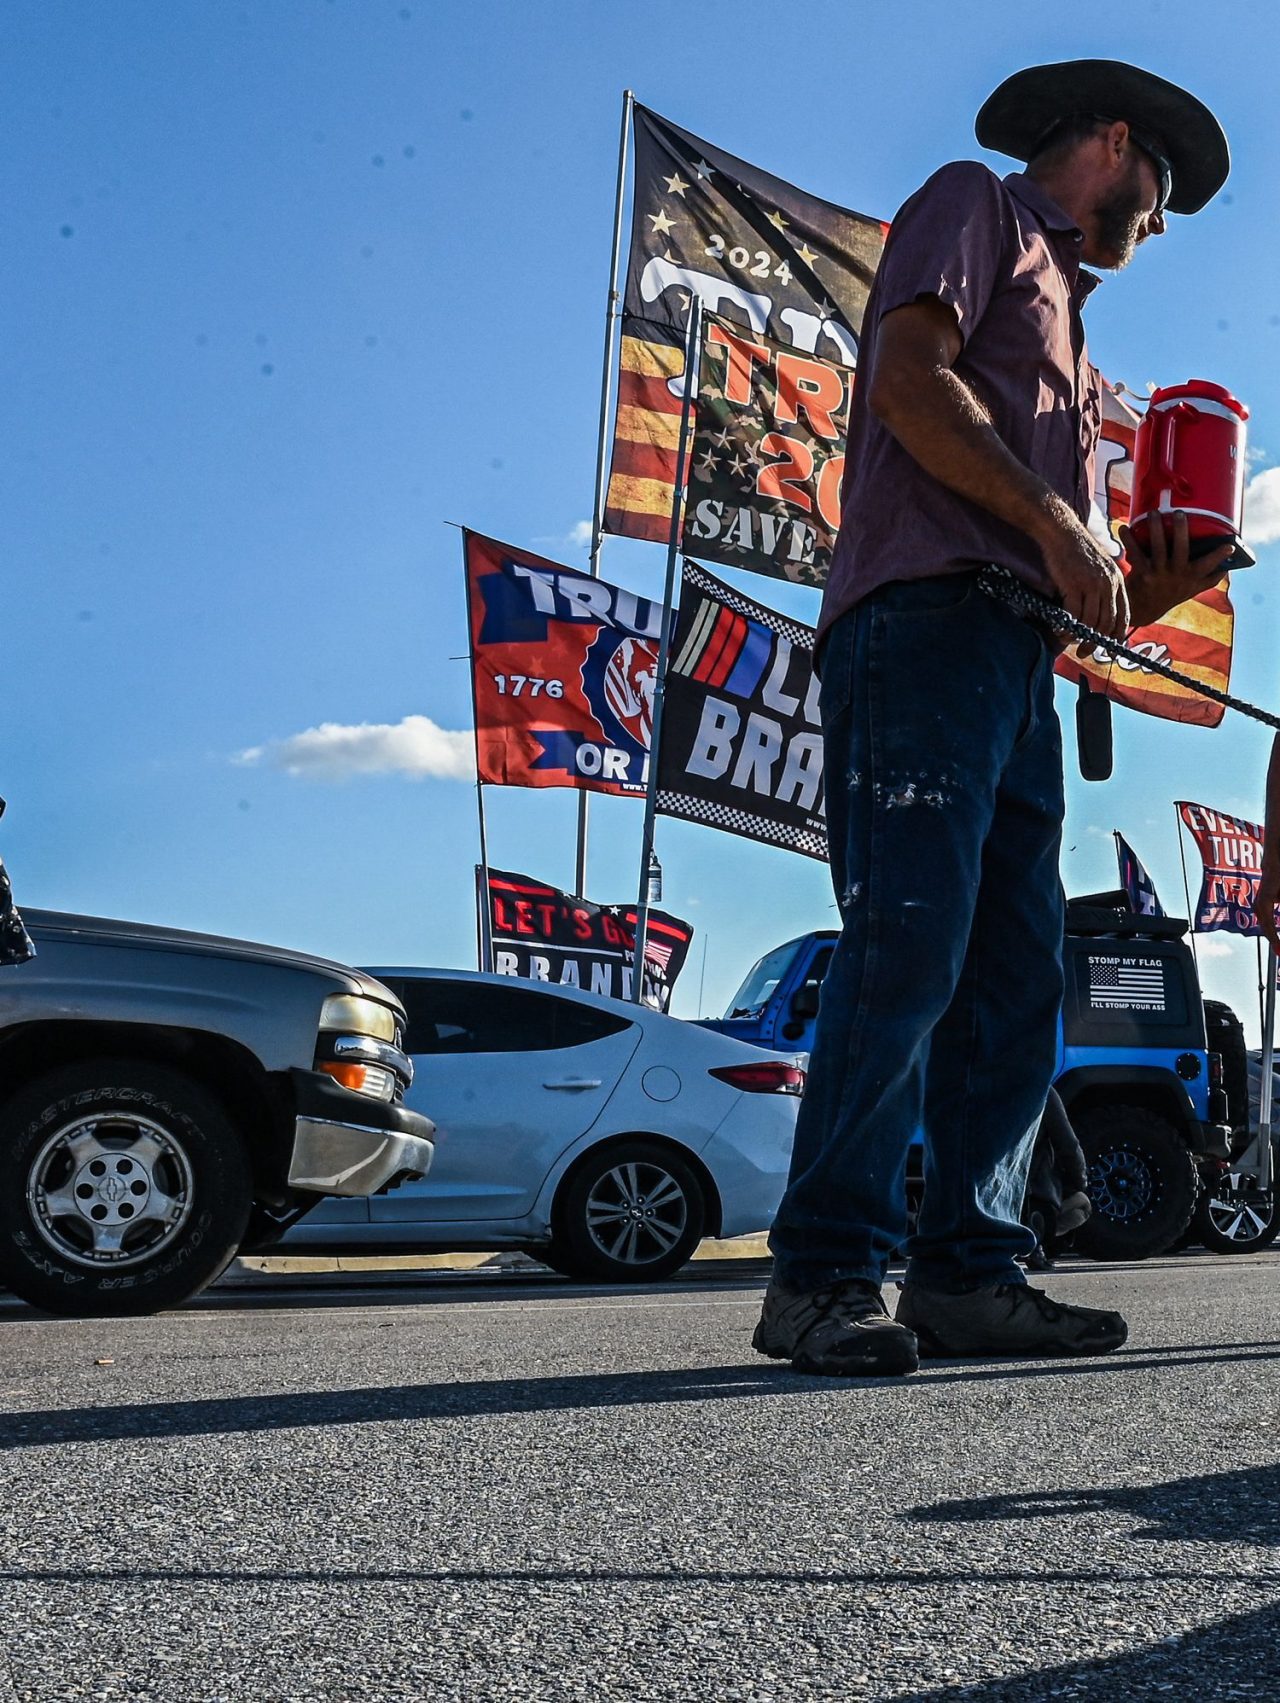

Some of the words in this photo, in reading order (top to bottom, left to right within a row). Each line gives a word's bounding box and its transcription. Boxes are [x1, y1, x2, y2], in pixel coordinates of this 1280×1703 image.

[704, 234, 794, 286] 2024
[707, 322, 855, 441] TR
[691, 499, 818, 564] SAVE
[513, 563, 662, 640] TRU
[493, 673, 565, 700] 1776
[575, 743, 630, 781] OR
[685, 694, 826, 818] BRA
[1207, 835, 1265, 870] TURN
[1205, 873, 1262, 909] TR
[493, 896, 593, 940] LET'S
[1088, 956, 1121, 965] STOMP
[1122, 957, 1136, 966] MY
[1139, 958, 1163, 967] FLAG
